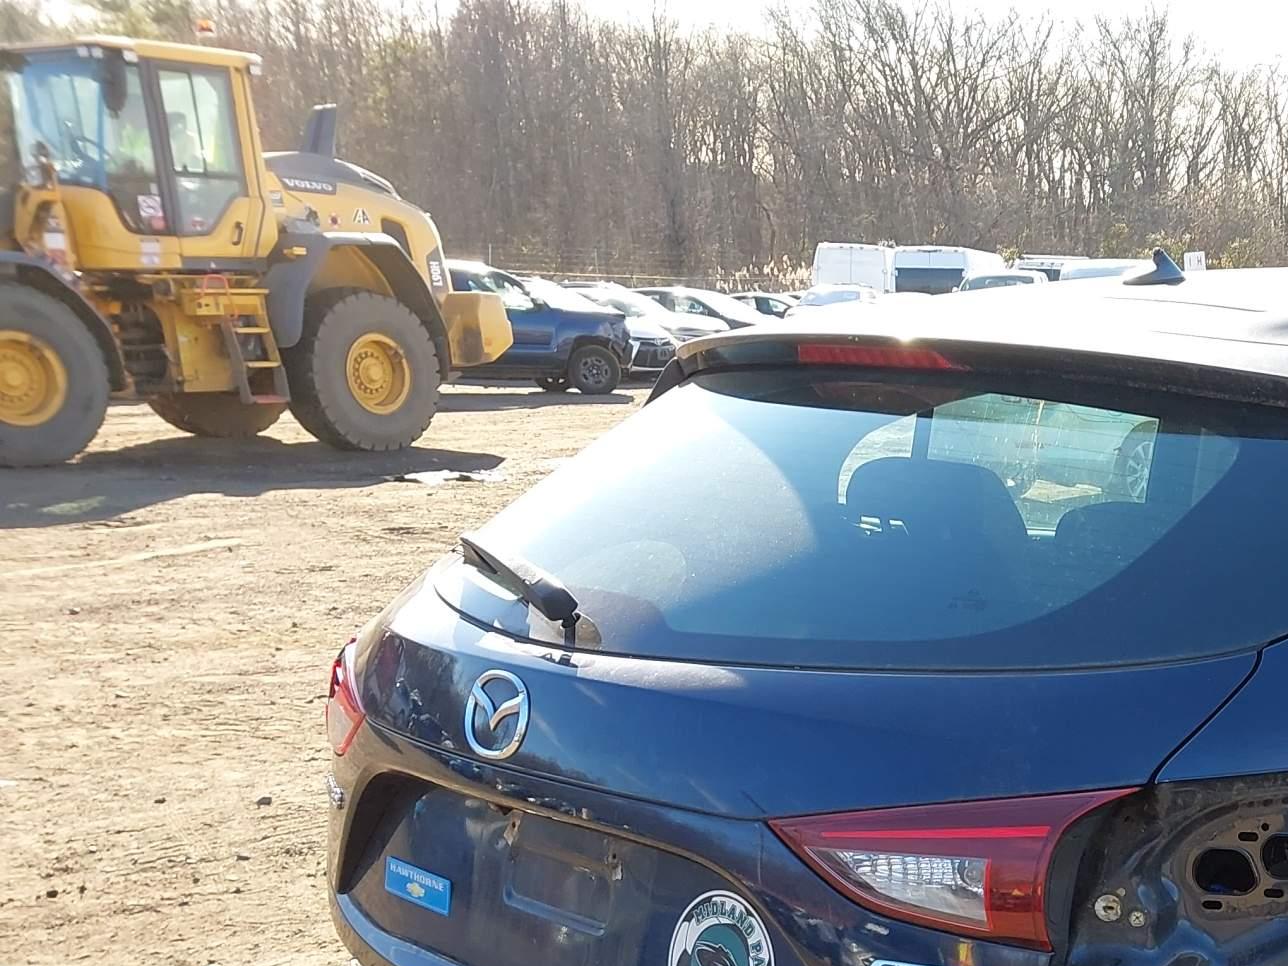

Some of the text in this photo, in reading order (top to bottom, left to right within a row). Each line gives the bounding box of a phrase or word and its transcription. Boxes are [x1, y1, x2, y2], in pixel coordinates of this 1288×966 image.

[282, 177, 333, 191] VOLVO
[390, 862, 444, 892] HAWTHORNE
[693, 901, 755, 937] MIDLAND
